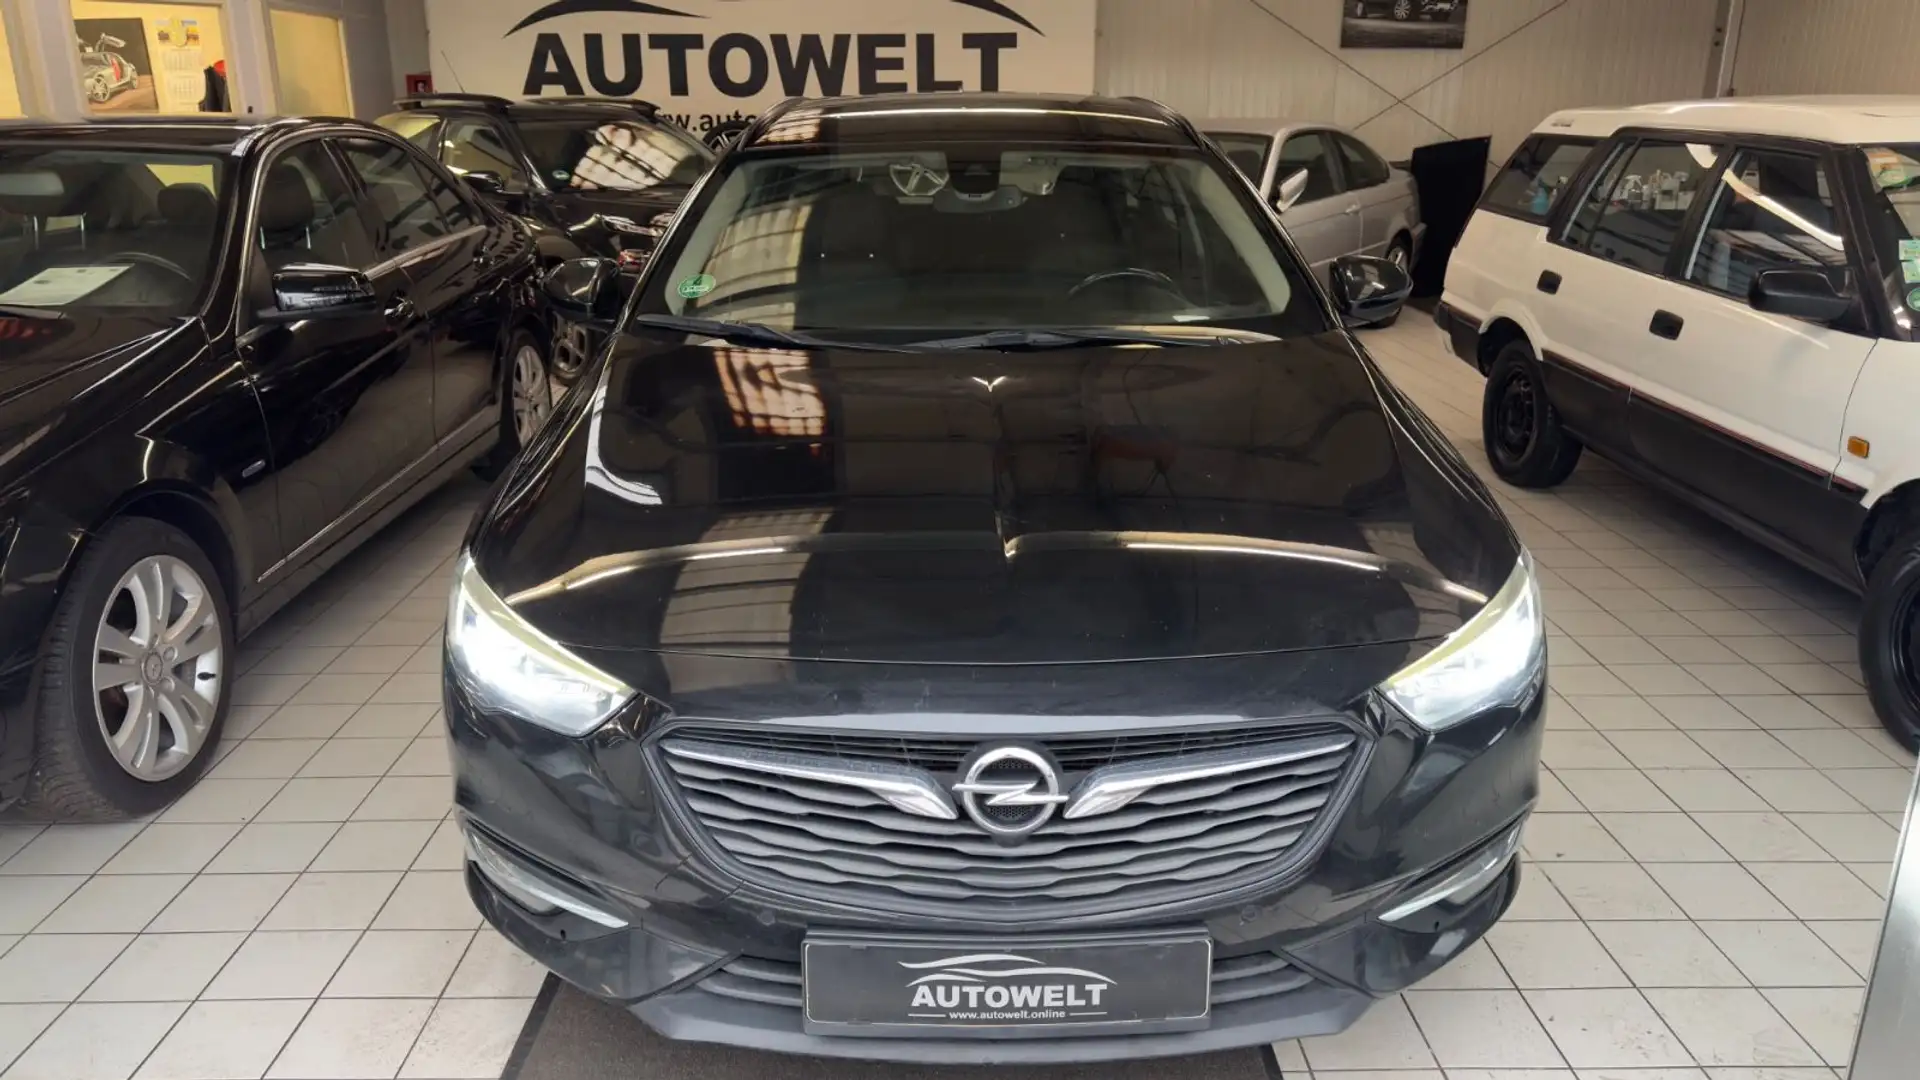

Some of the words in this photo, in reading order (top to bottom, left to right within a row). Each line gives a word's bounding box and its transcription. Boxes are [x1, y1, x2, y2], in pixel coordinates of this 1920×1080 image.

[522, 32, 1018, 98] AUTOWELT
[911, 983, 1108, 1008] AUTOWELT
[949, 1008, 1066, 1020] www.autowelt.online
